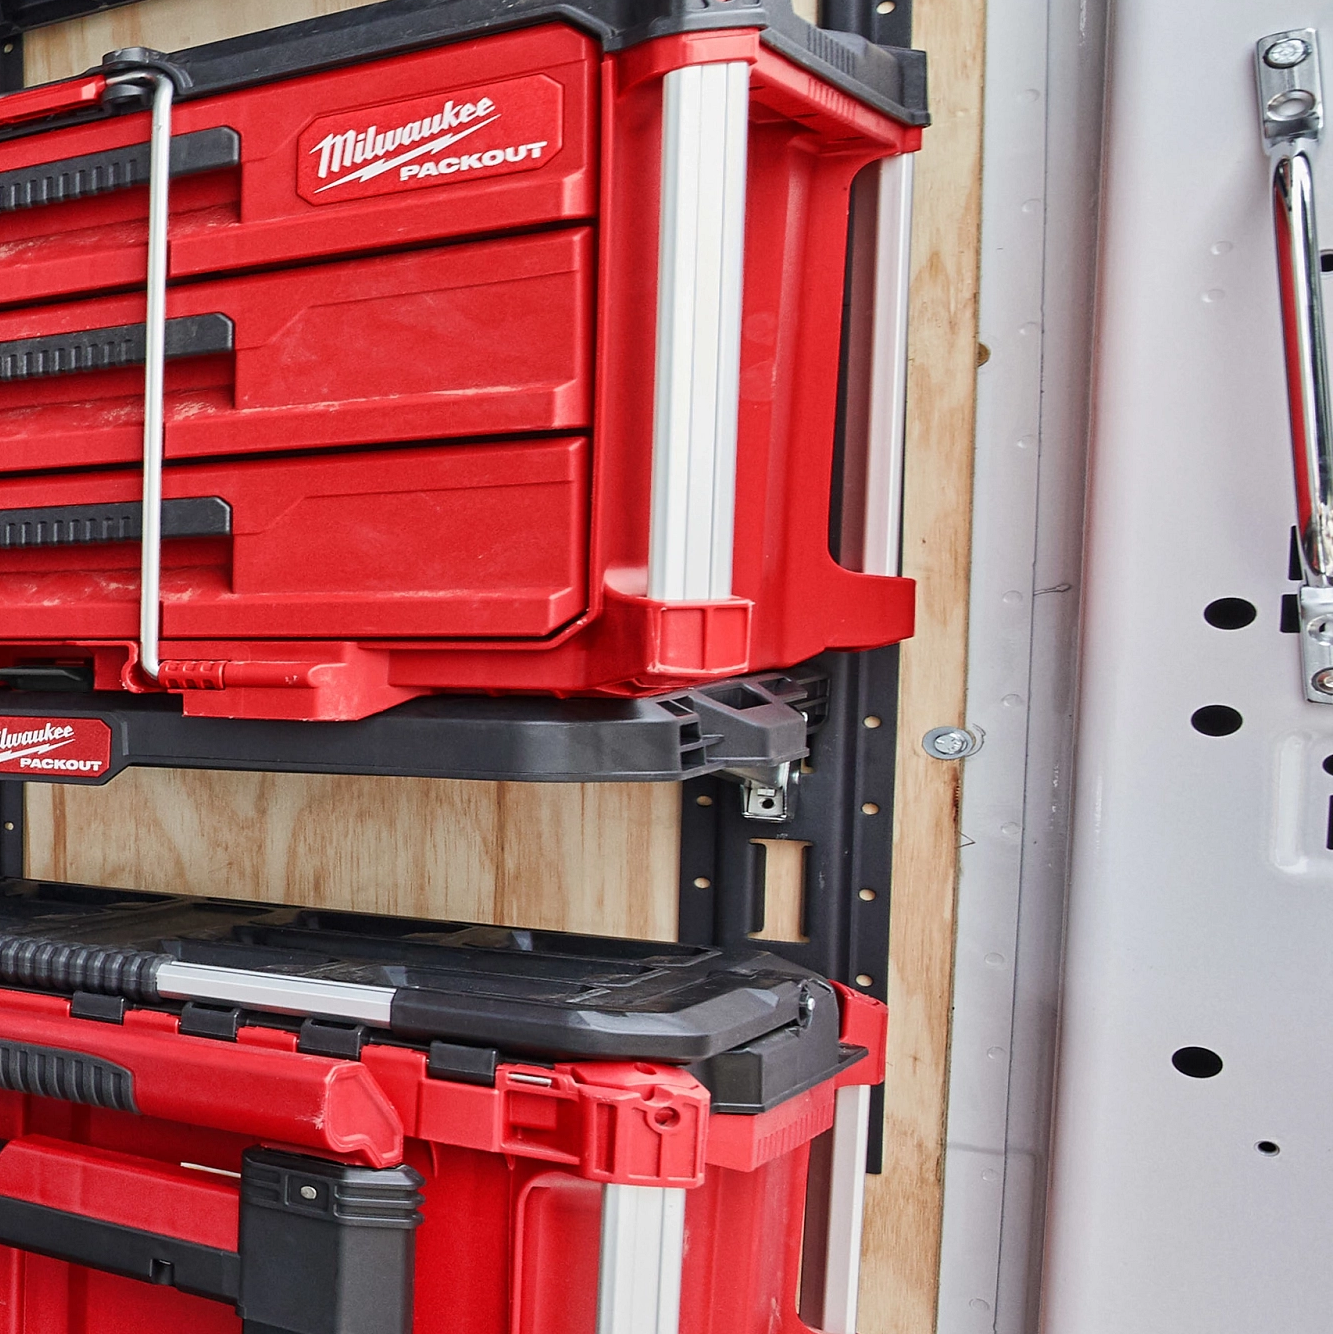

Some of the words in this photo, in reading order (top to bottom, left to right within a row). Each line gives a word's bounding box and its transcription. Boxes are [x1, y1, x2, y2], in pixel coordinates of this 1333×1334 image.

[309, 97, 496, 178] Milwaukee
[399, 141, 548, 181] PACKOUT
[20, 757, 102, 771] PACKOUT
